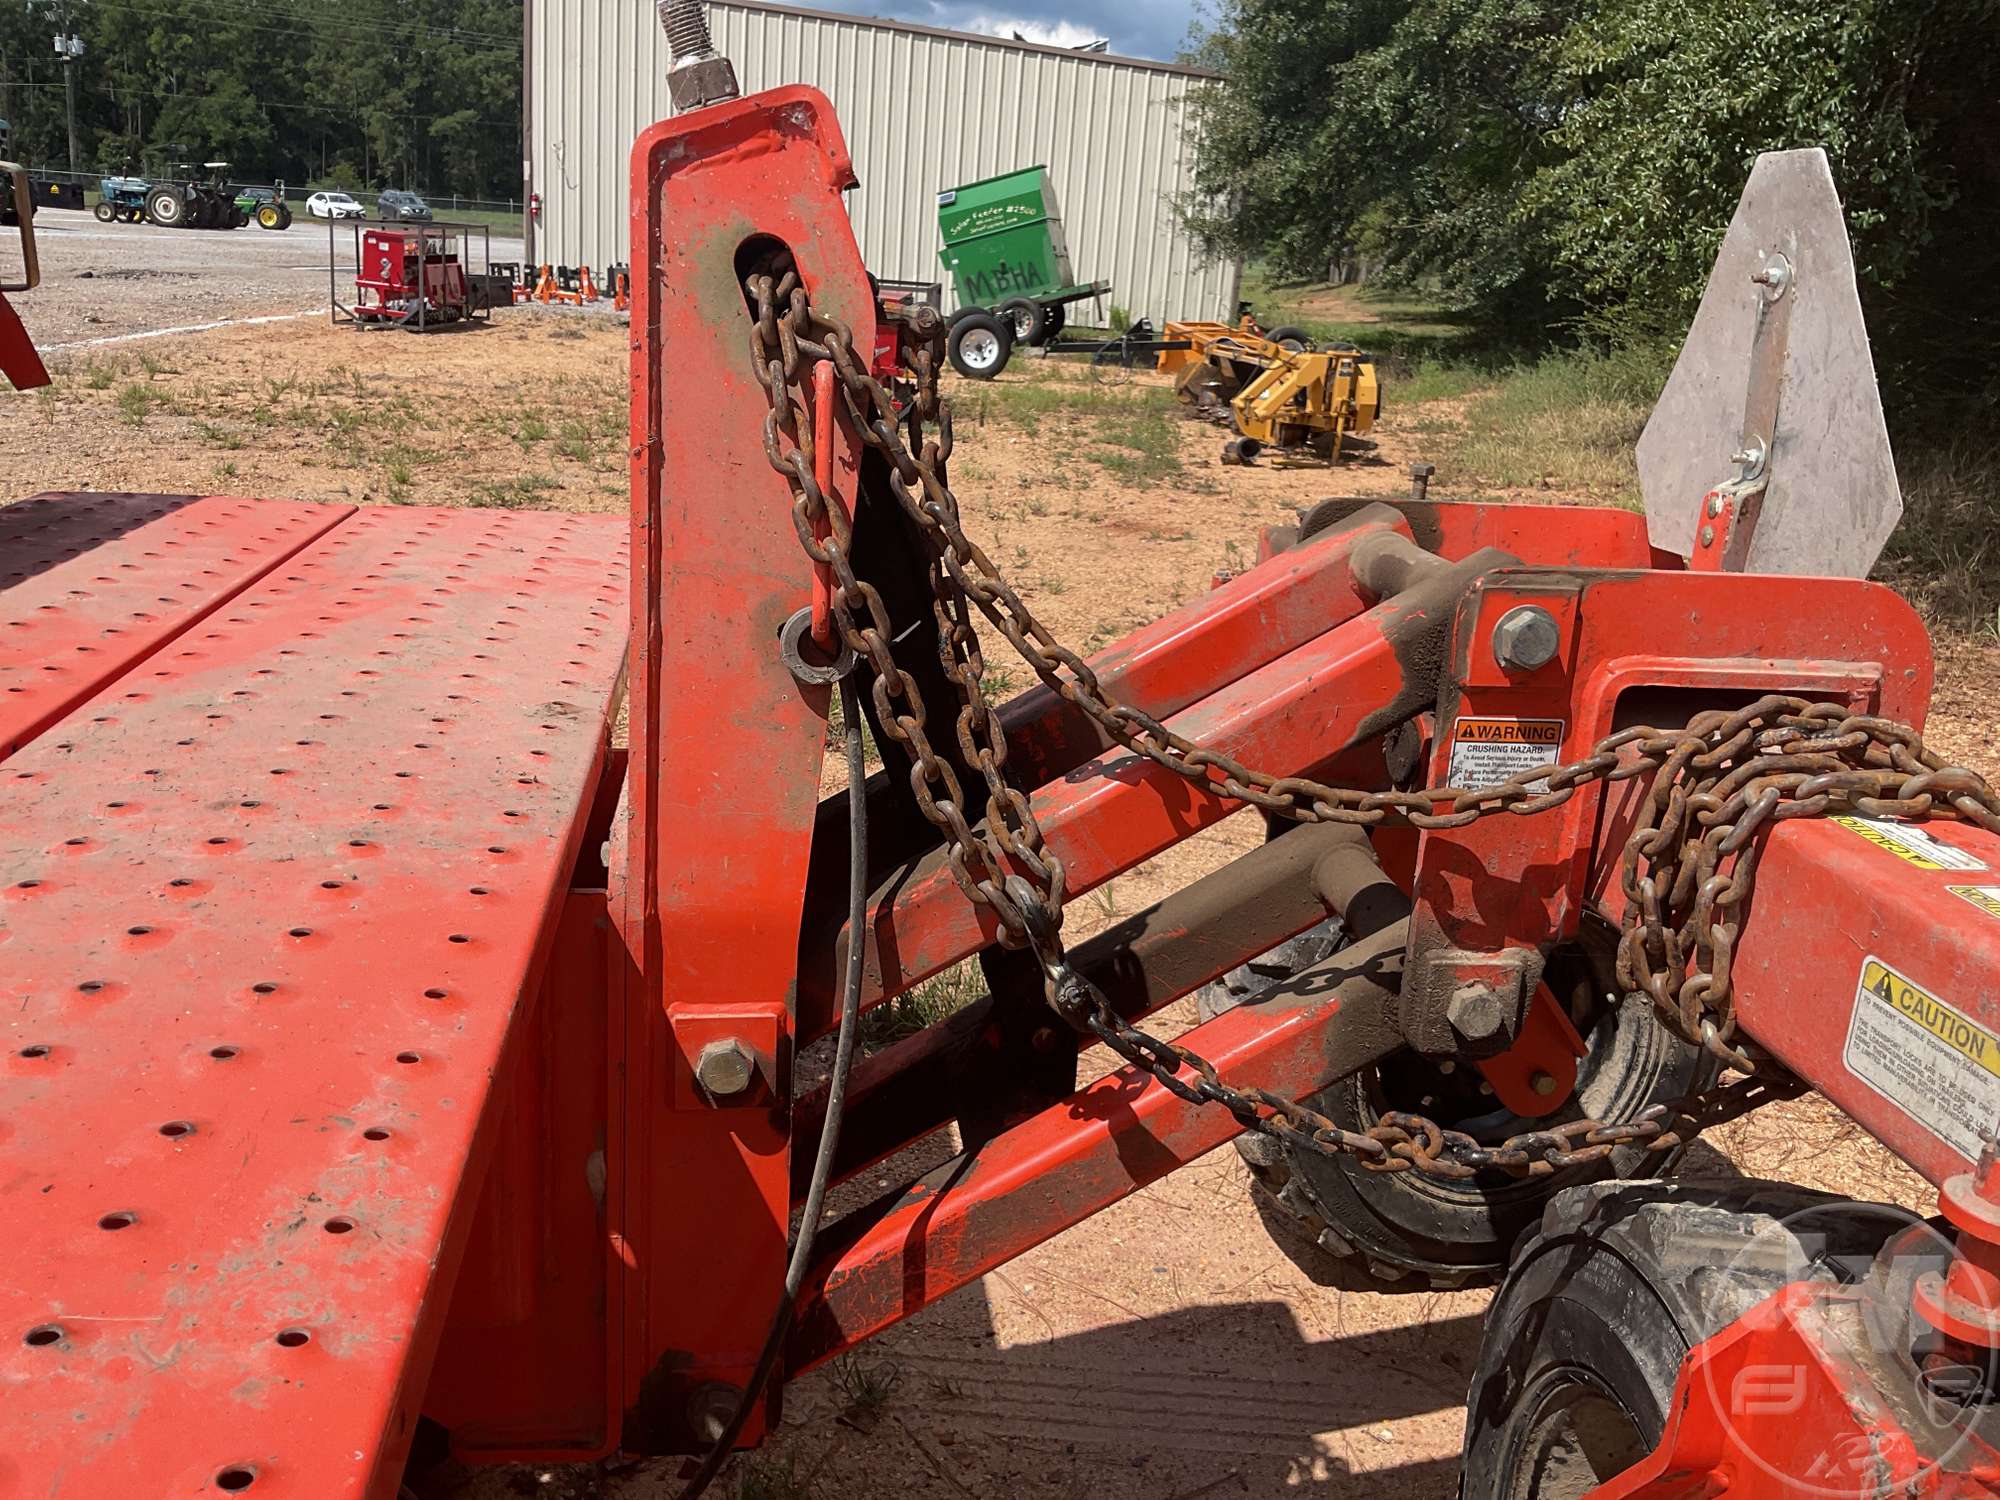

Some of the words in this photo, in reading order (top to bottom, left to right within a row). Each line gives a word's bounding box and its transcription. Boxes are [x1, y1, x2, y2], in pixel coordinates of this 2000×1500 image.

[1477, 725, 1556, 740] WARNING
[1467, 744, 1508, 753] CRUSHING
[1510, 745, 1545, 754] HAZARD.
[1836, 818, 1911, 853] CAUTIO
[1863, 995, 1871, 1004] TO
[1899, 988, 1987, 1059] CAUTION
